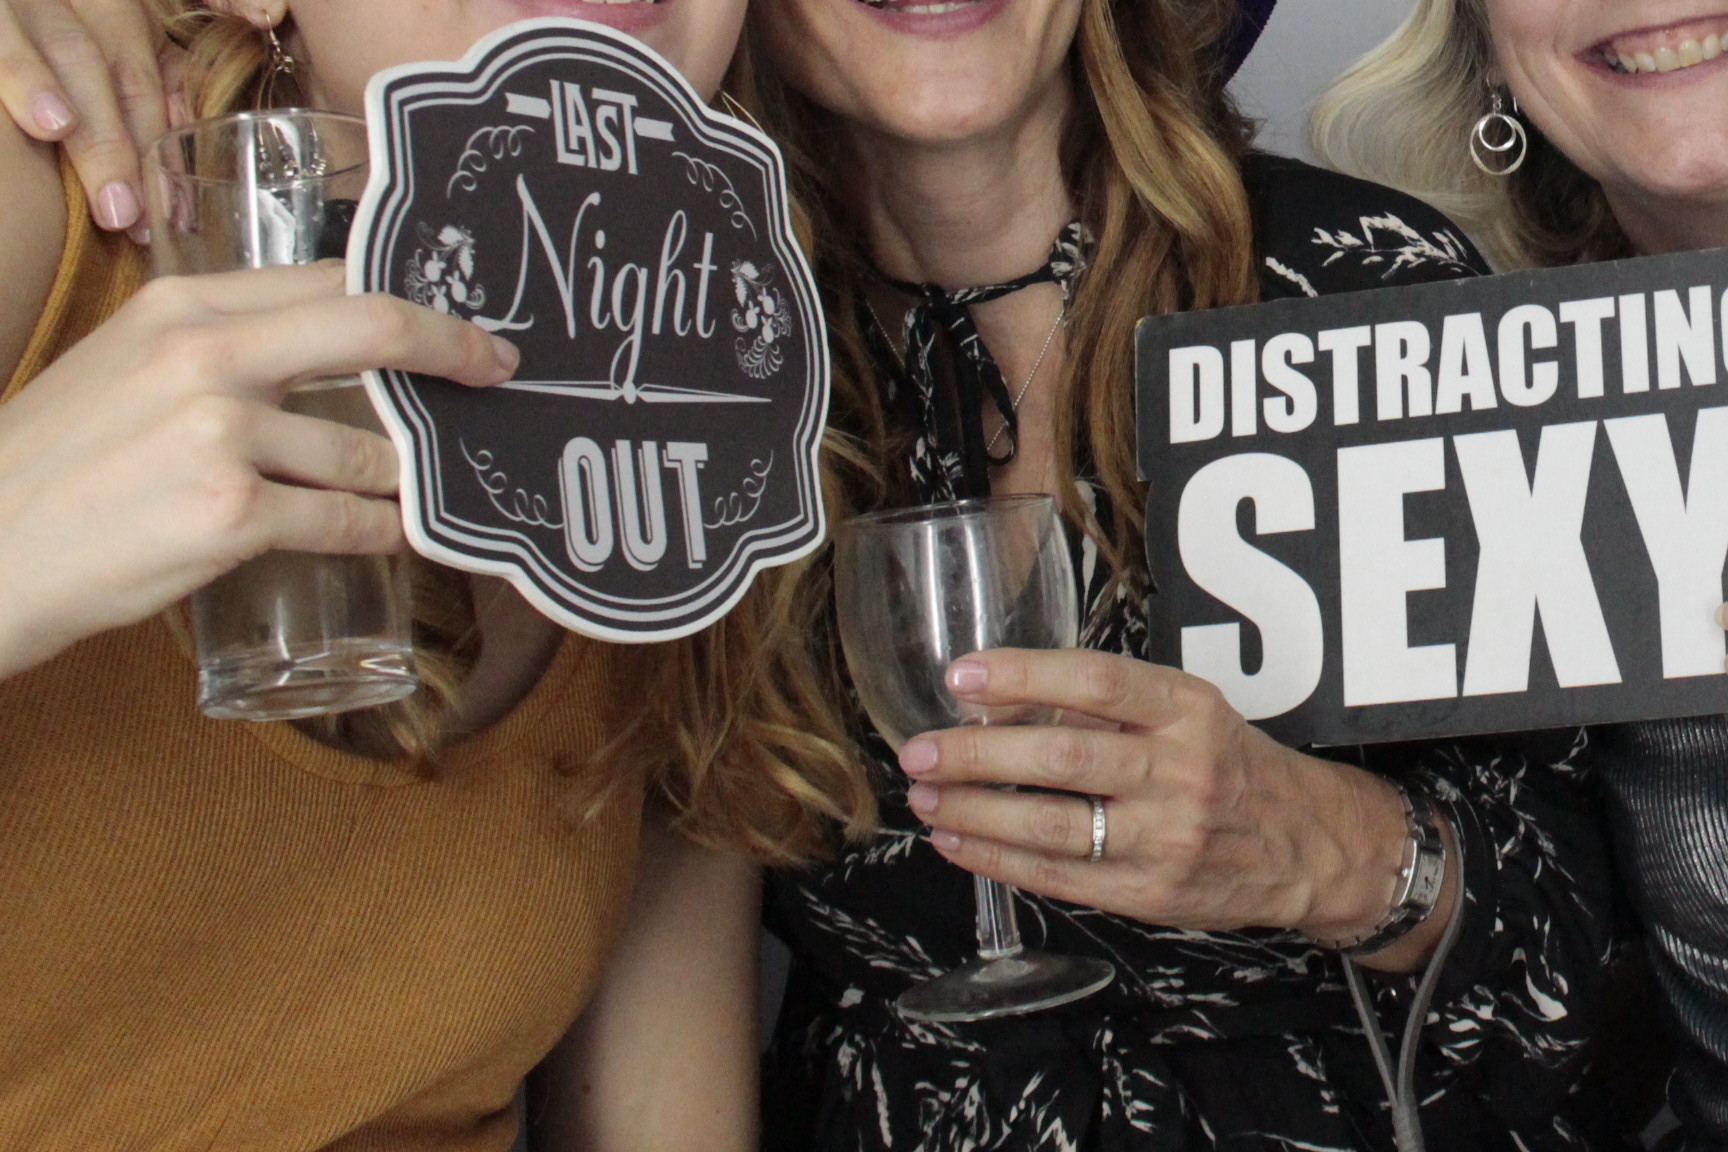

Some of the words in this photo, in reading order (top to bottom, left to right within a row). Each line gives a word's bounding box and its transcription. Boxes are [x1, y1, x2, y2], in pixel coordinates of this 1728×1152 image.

[549, 79, 640, 174] LAST
[473, 174, 718, 391] Night
[559, 436, 709, 572] OUT
